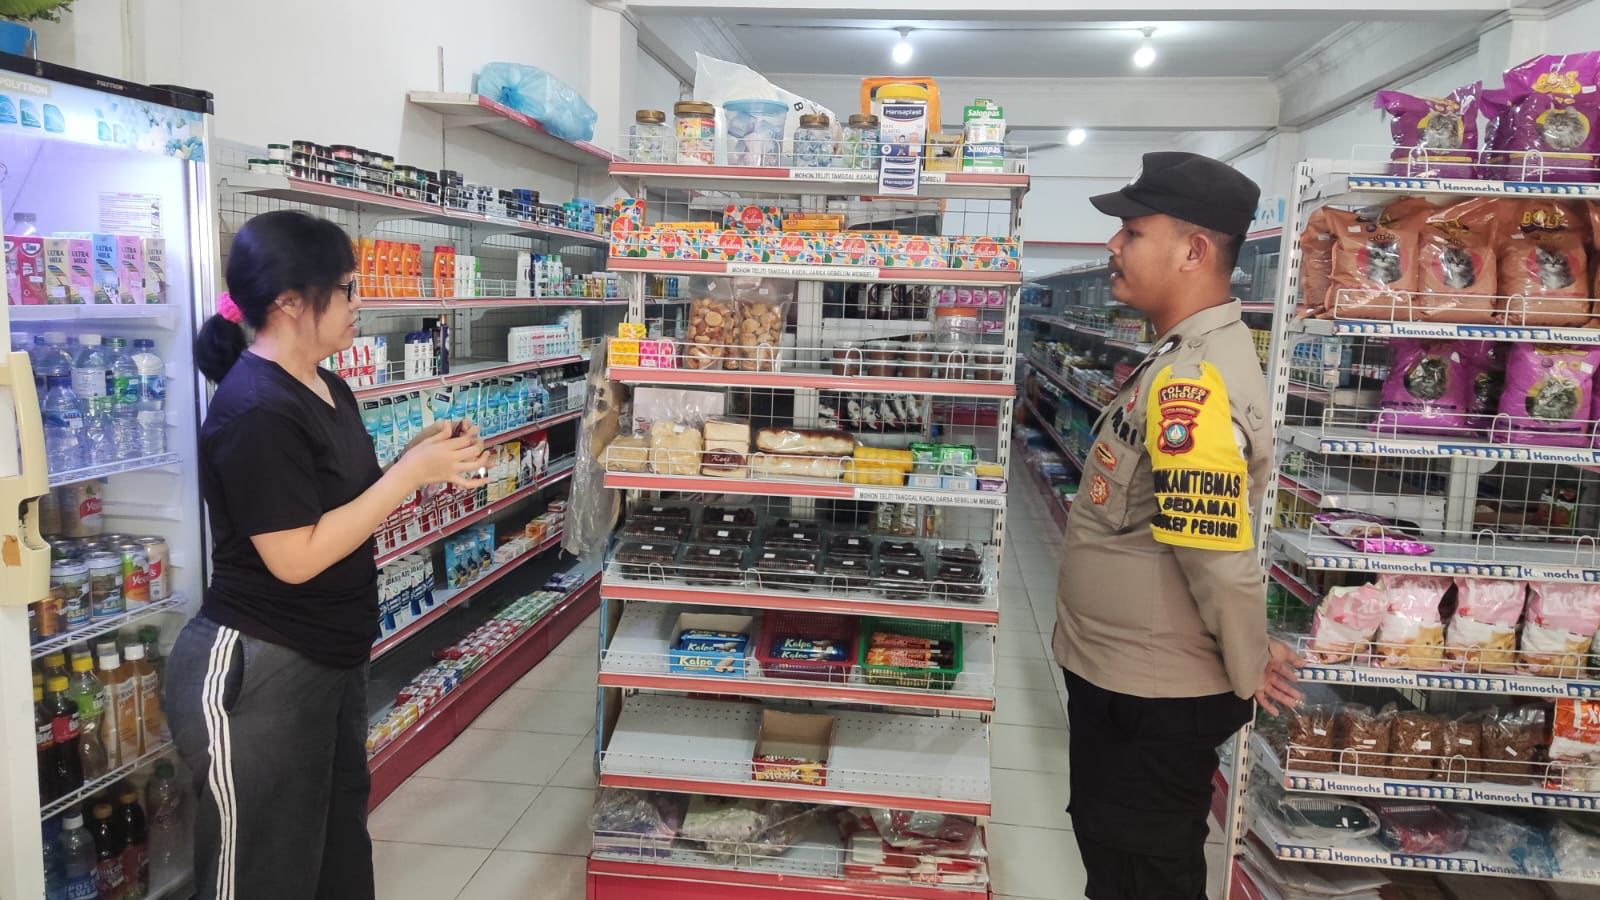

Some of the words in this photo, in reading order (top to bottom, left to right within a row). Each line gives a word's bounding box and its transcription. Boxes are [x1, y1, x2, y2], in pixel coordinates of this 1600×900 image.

[1397, 326, 1454, 336] Hannochs
[1161, 385, 1206, 396] POLRES
[1163, 392, 1201, 401] LINGGA
[1378, 444, 1435, 456] Hannochs
[1534, 451, 1589, 463] Hannochs
[1163, 497, 1236, 518] SEDAMAI
[1191, 518, 1238, 538] PESISIR
[1371, 561, 1427, 573] Hannochs
[784, 638, 812, 650] Kalpa
[680, 655, 713, 667] Kalpa
[1358, 673, 1413, 685] Hannochs
[1509, 682, 1564, 694] Hannochs
[1327, 781, 1381, 793] Hannochs
[1474, 790, 1529, 803] Hannochs
[1334, 852, 1388, 865] Hannochs
